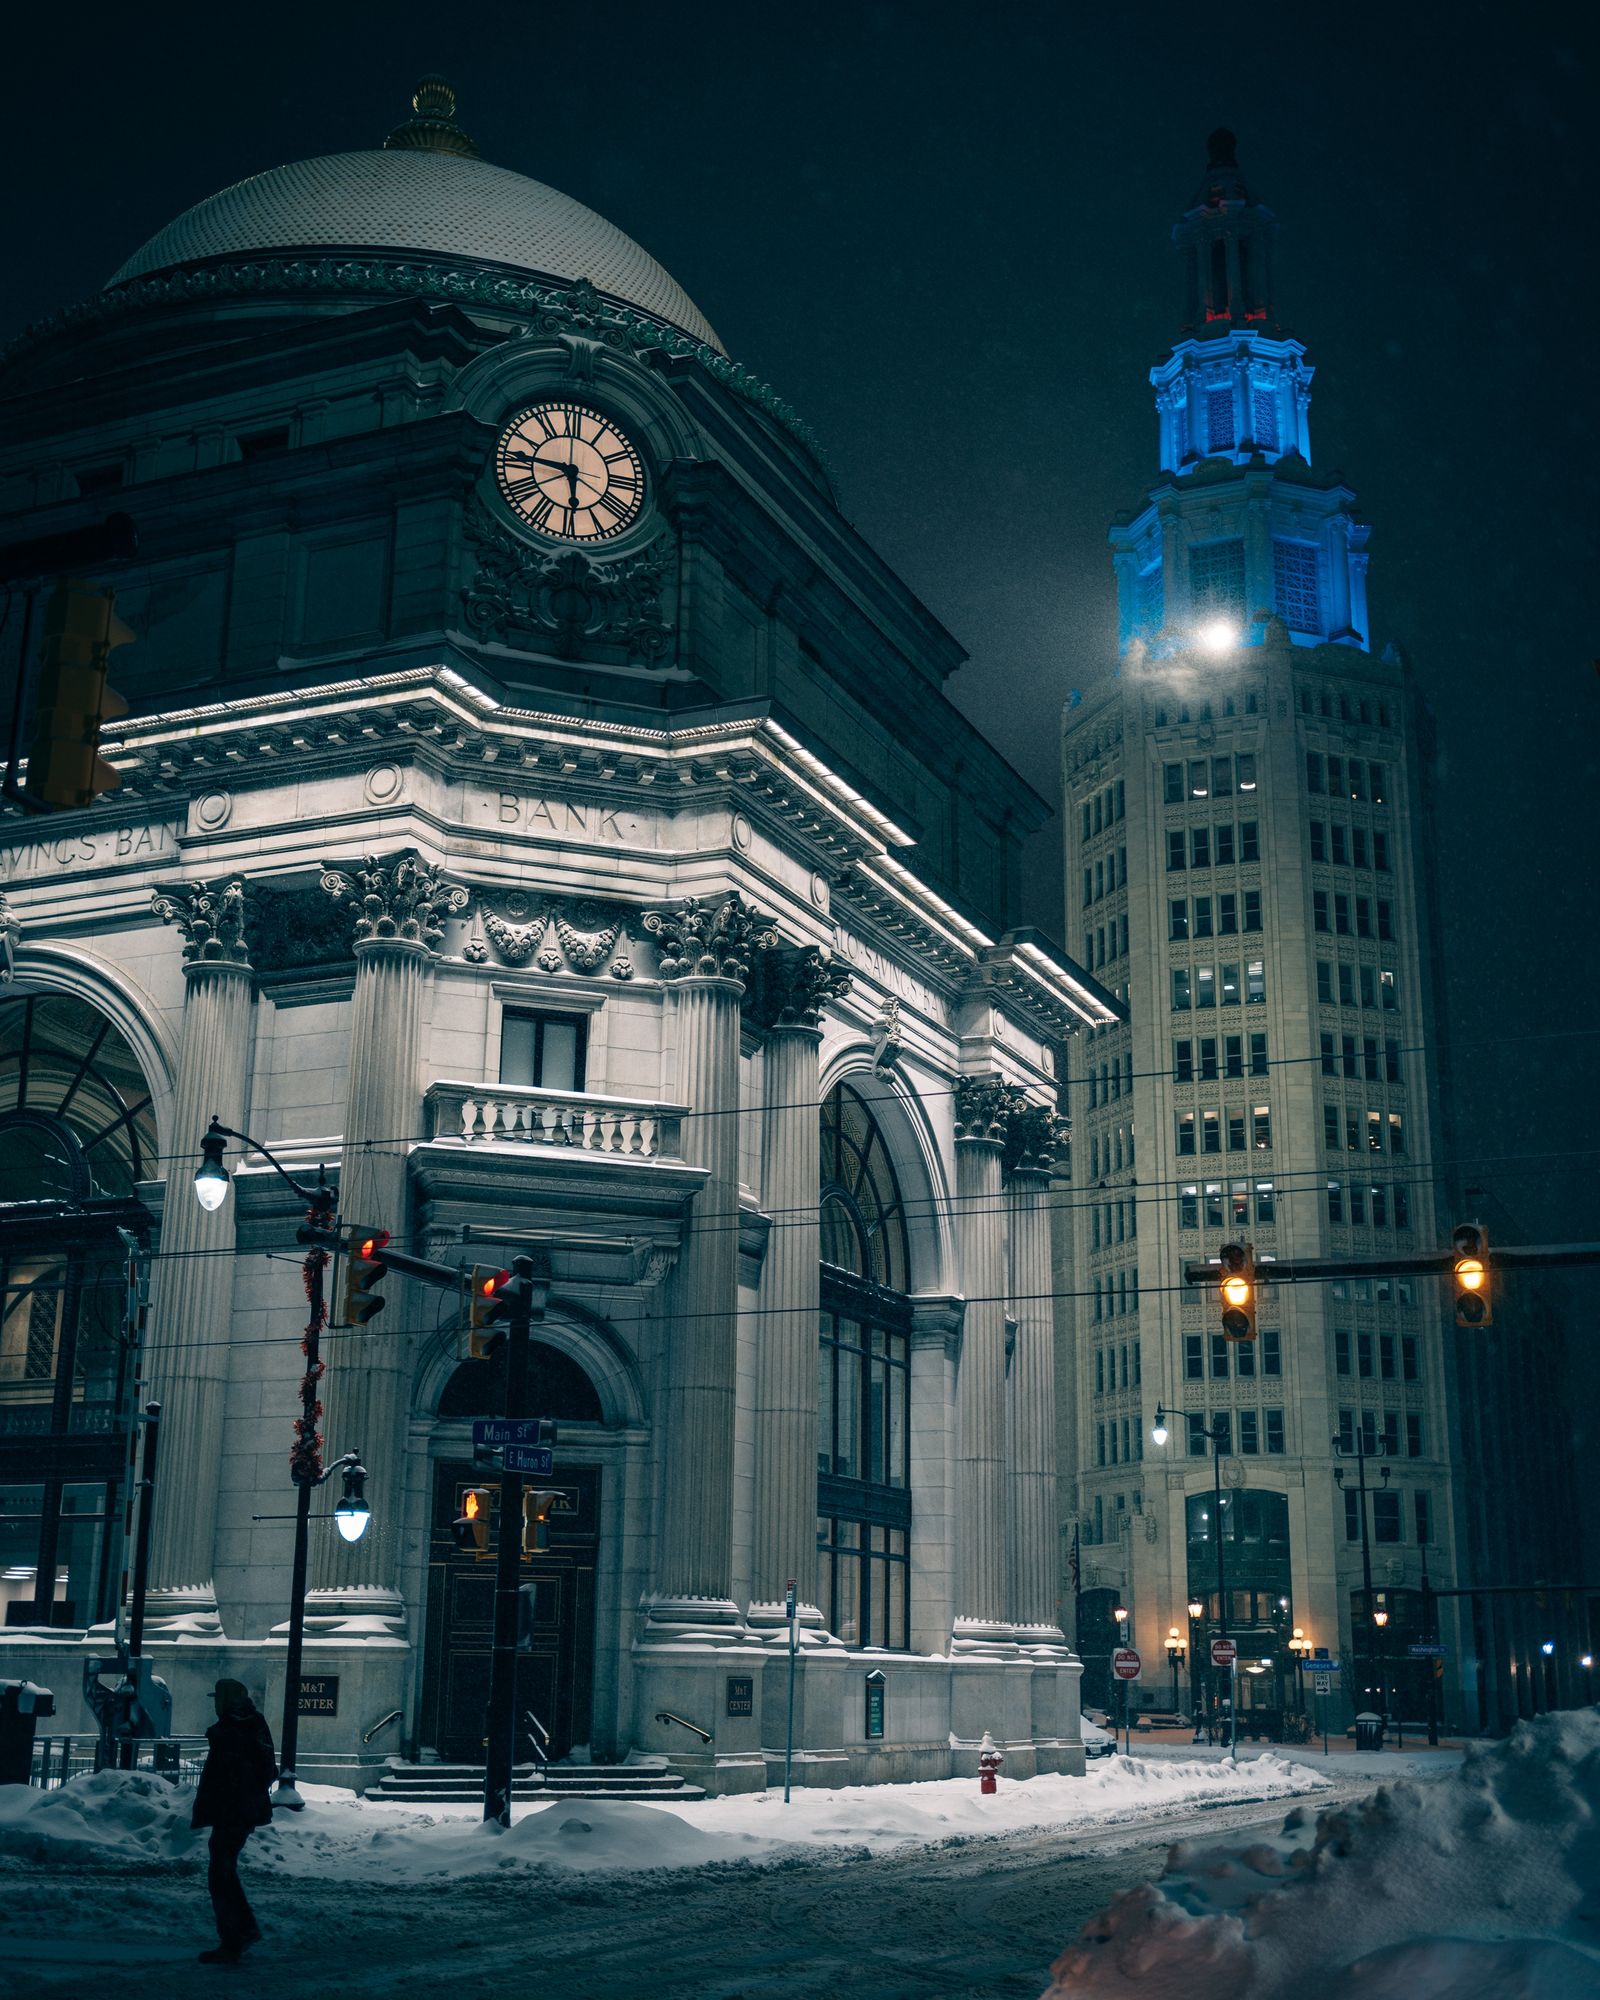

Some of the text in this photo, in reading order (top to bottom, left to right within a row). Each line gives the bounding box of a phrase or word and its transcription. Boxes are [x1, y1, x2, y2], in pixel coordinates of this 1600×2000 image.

[564, 411, 582, 439] XII
[498, 791, 624, 840] BANK
[865, 944, 917, 1003] SAVINGS
[484, 1424, 510, 1441] Main
[509, 1451, 515, 1464] E
[517, 1450, 539, 1469] Huron
[300, 1683, 325, 1693] M&T
[729, 1700, 751, 1711] CENTER
